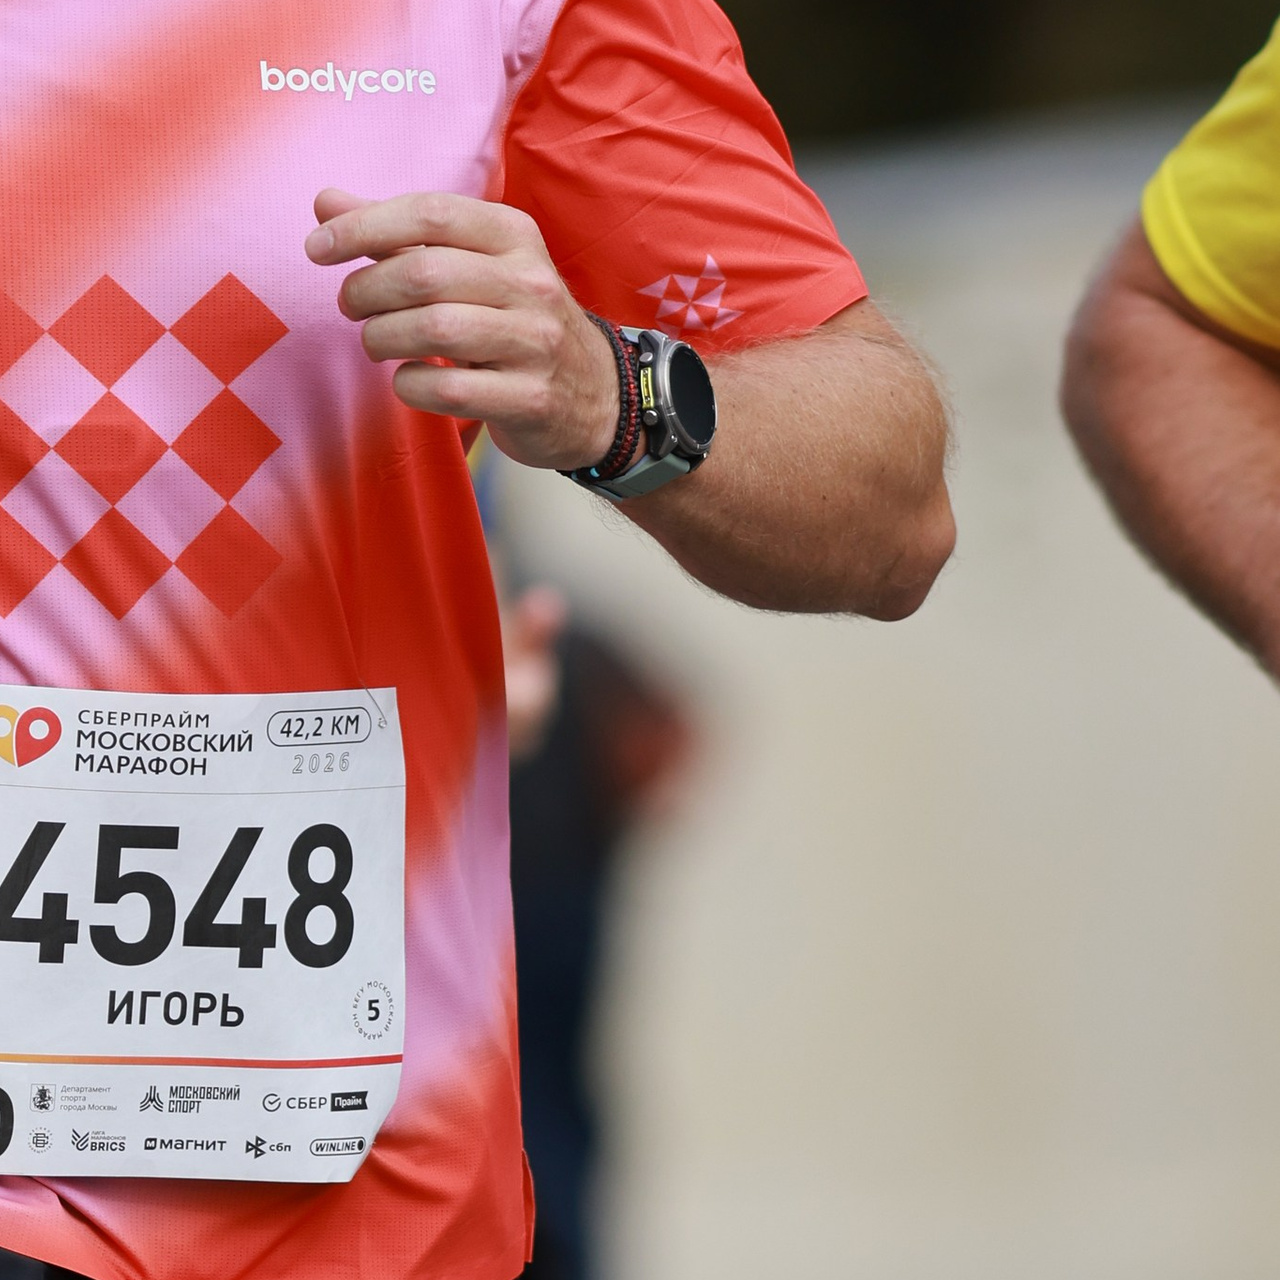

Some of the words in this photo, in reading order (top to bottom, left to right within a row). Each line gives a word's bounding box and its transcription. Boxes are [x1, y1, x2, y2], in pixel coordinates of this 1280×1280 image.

[260, 60, 436, 101] bodycore
[78, 710, 209, 728] СБЕРПРАЙМ
[280, 717, 323, 740] 42,2
[76, 730, 252, 752] МОСКОВСКИЙ
[75, 754, 207, 776] МАРАФОН
[292, 752, 349, 774] 2026
[107, 990, 245, 1027] ИГОРЬ
[368, 999, 380, 1021] 5
[61, 1085, 111, 1093] Департамент
[169, 1084, 240, 1100] МОСКОВСКИЙ
[168, 1100, 201, 1113] СПОРТ
[286, 1097, 327, 1109] СБЕР
[90, 1142, 125, 1151] BRICS
[315, 1142, 356, 1152] WINLINE
